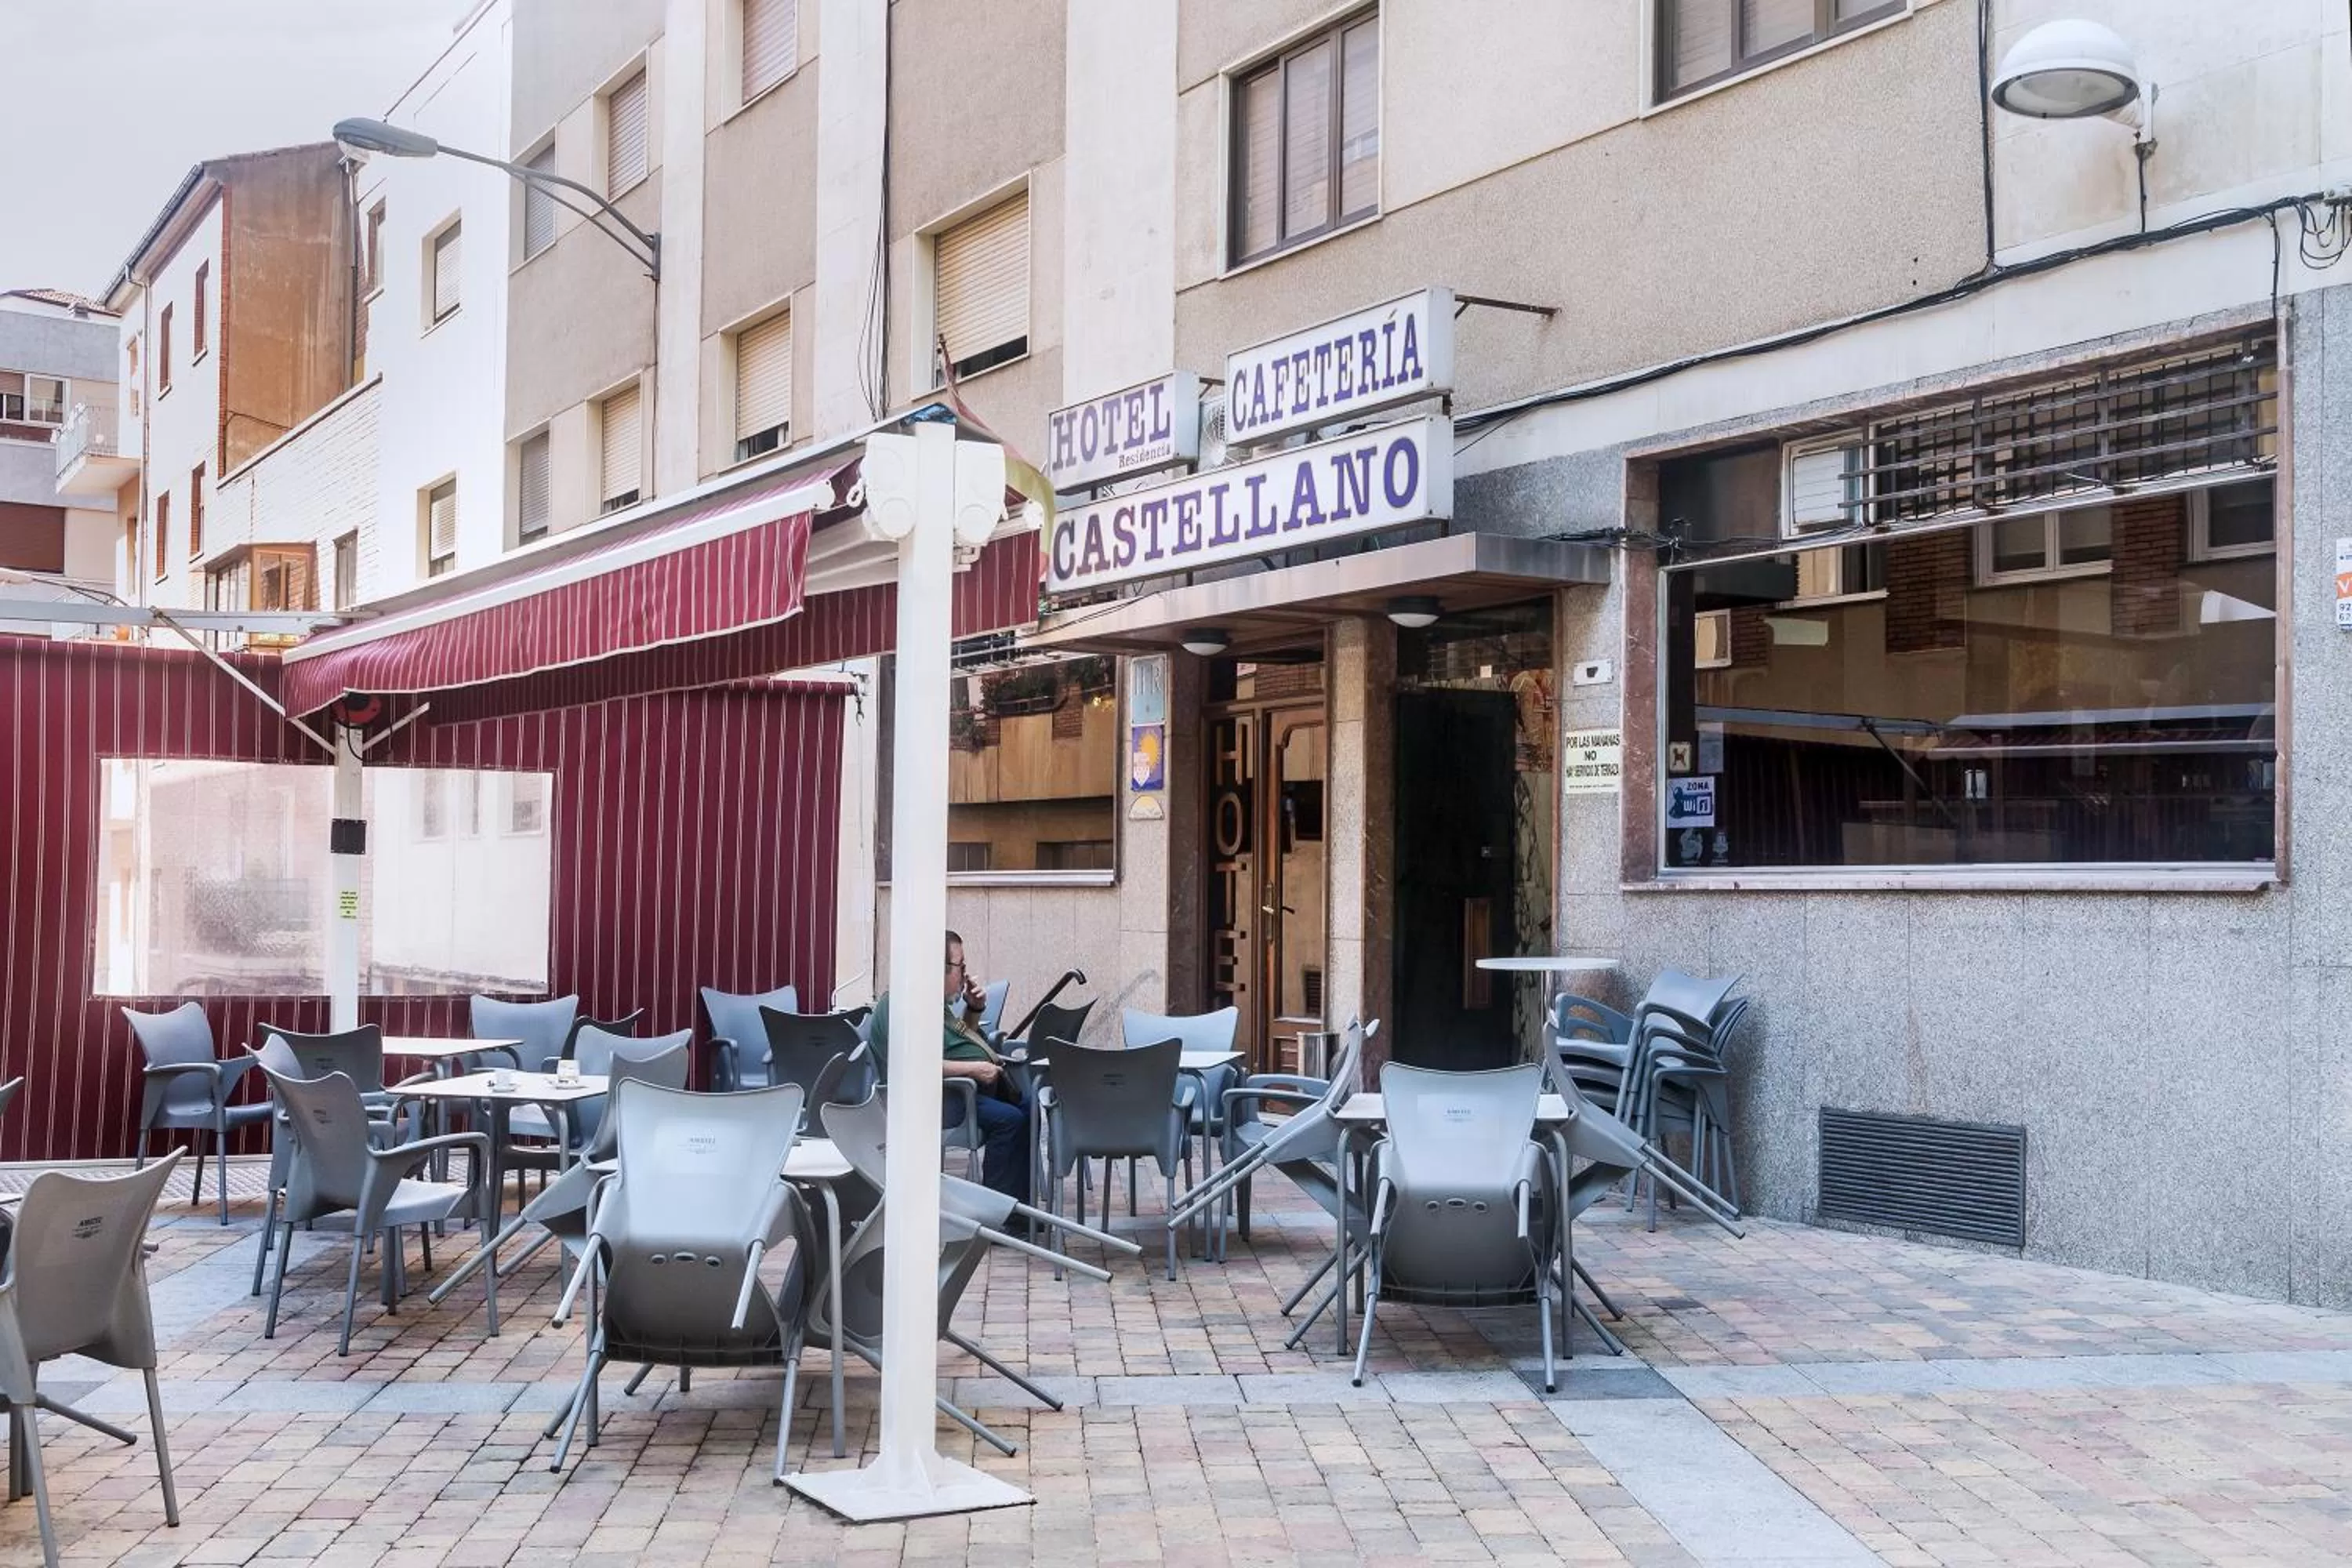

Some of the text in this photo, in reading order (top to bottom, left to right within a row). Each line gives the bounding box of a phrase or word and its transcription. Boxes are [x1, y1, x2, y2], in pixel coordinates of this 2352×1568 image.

[1232, 310, 1424, 433] CAFETERÍA
[1052, 383, 1171, 470] HOTEL
[1118, 444, 1171, 469] Residencia
[1052, 436, 1420, 581] CASTELLANO
[1578, 735, 1590, 748] LAS
[1584, 750, 1597, 761] NO
[1686, 781, 1710, 791] ZONA
[1215, 715, 1247, 1011] HOTE
